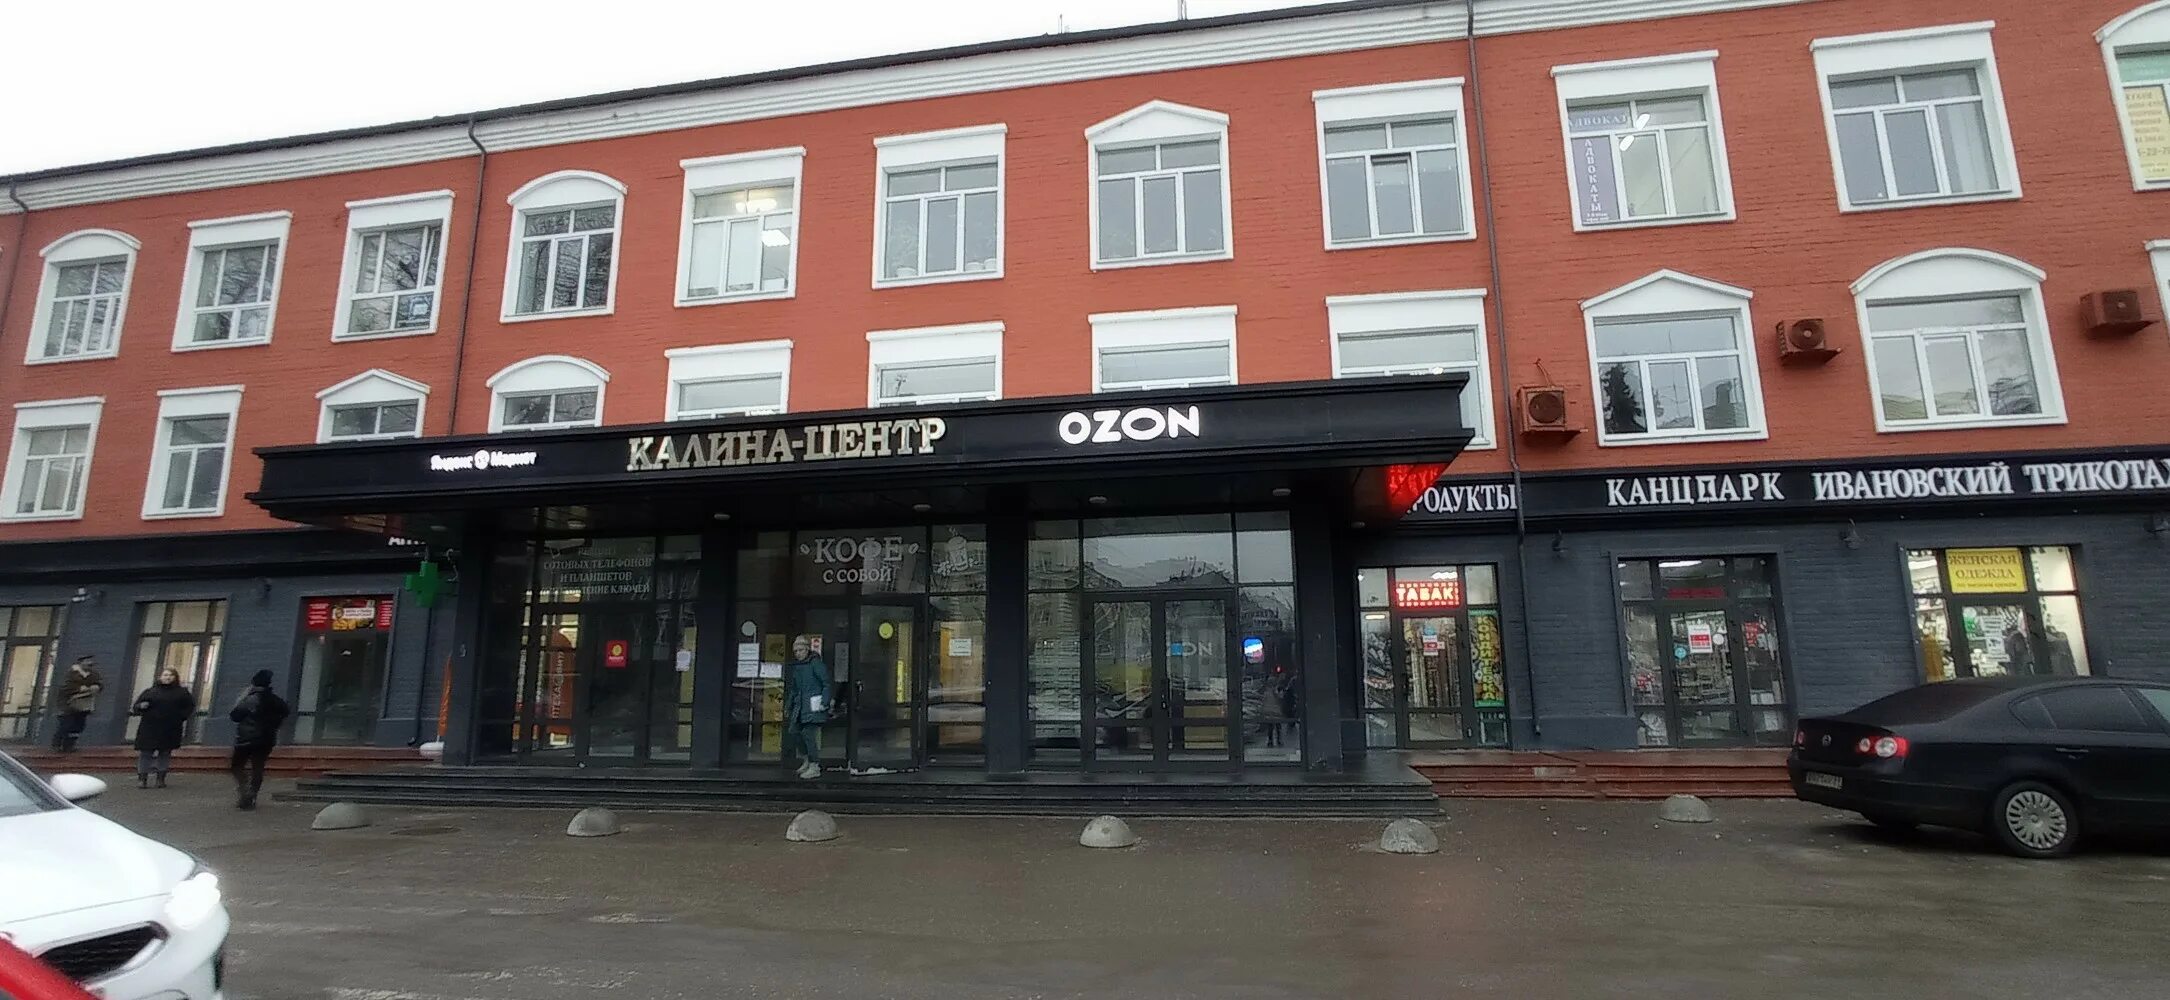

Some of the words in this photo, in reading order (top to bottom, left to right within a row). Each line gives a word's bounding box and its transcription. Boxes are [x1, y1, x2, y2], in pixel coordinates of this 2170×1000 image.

[1584, 138, 1602, 212] АДВОКАТЫ
[1058, 405, 1201, 445] OZON
[627, 417, 947, 472] КАЛИНА-ЦЕНТР
[1811, 461, 2014, 501] ИВАНОВСКИЙ
[1407, 483, 1518, 513] ОДУКТЫ
[814, 536, 904, 563] КОФЕ
[1949, 554, 2018, 566] ЖЕНСКАЯ
[823, 569, 834, 584] С
[836, 561, 893, 583] СОБОЙ
[1955, 568, 2016, 579] ОДЕЖДА
